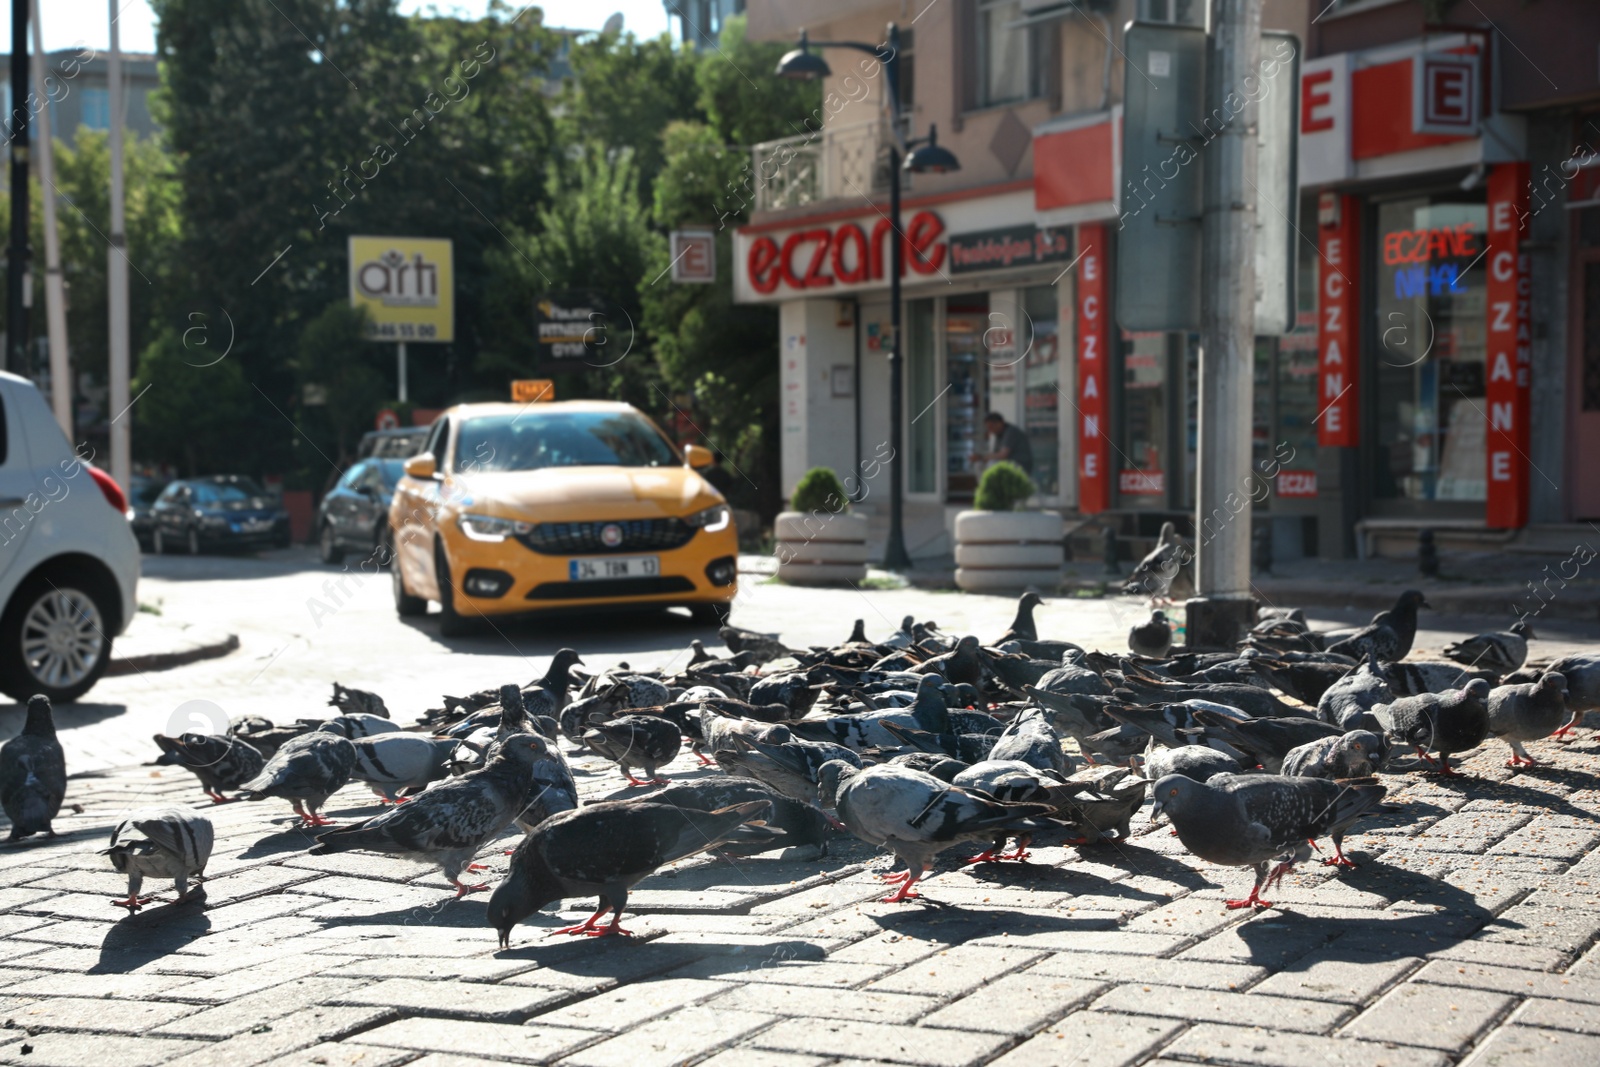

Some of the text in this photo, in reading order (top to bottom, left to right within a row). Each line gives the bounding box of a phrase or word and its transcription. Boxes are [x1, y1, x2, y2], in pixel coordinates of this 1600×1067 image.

[747, 210, 947, 295] eczane
[1382, 223, 1478, 266] ECZANE
[1082, 255, 1099, 479] ECZANE
[1324, 239, 1343, 433] ECZANE
[1492, 200, 1514, 482] ECZANE
[1516, 255, 1531, 388] ECZANE
[1119, 474, 1165, 491] ECZANE
